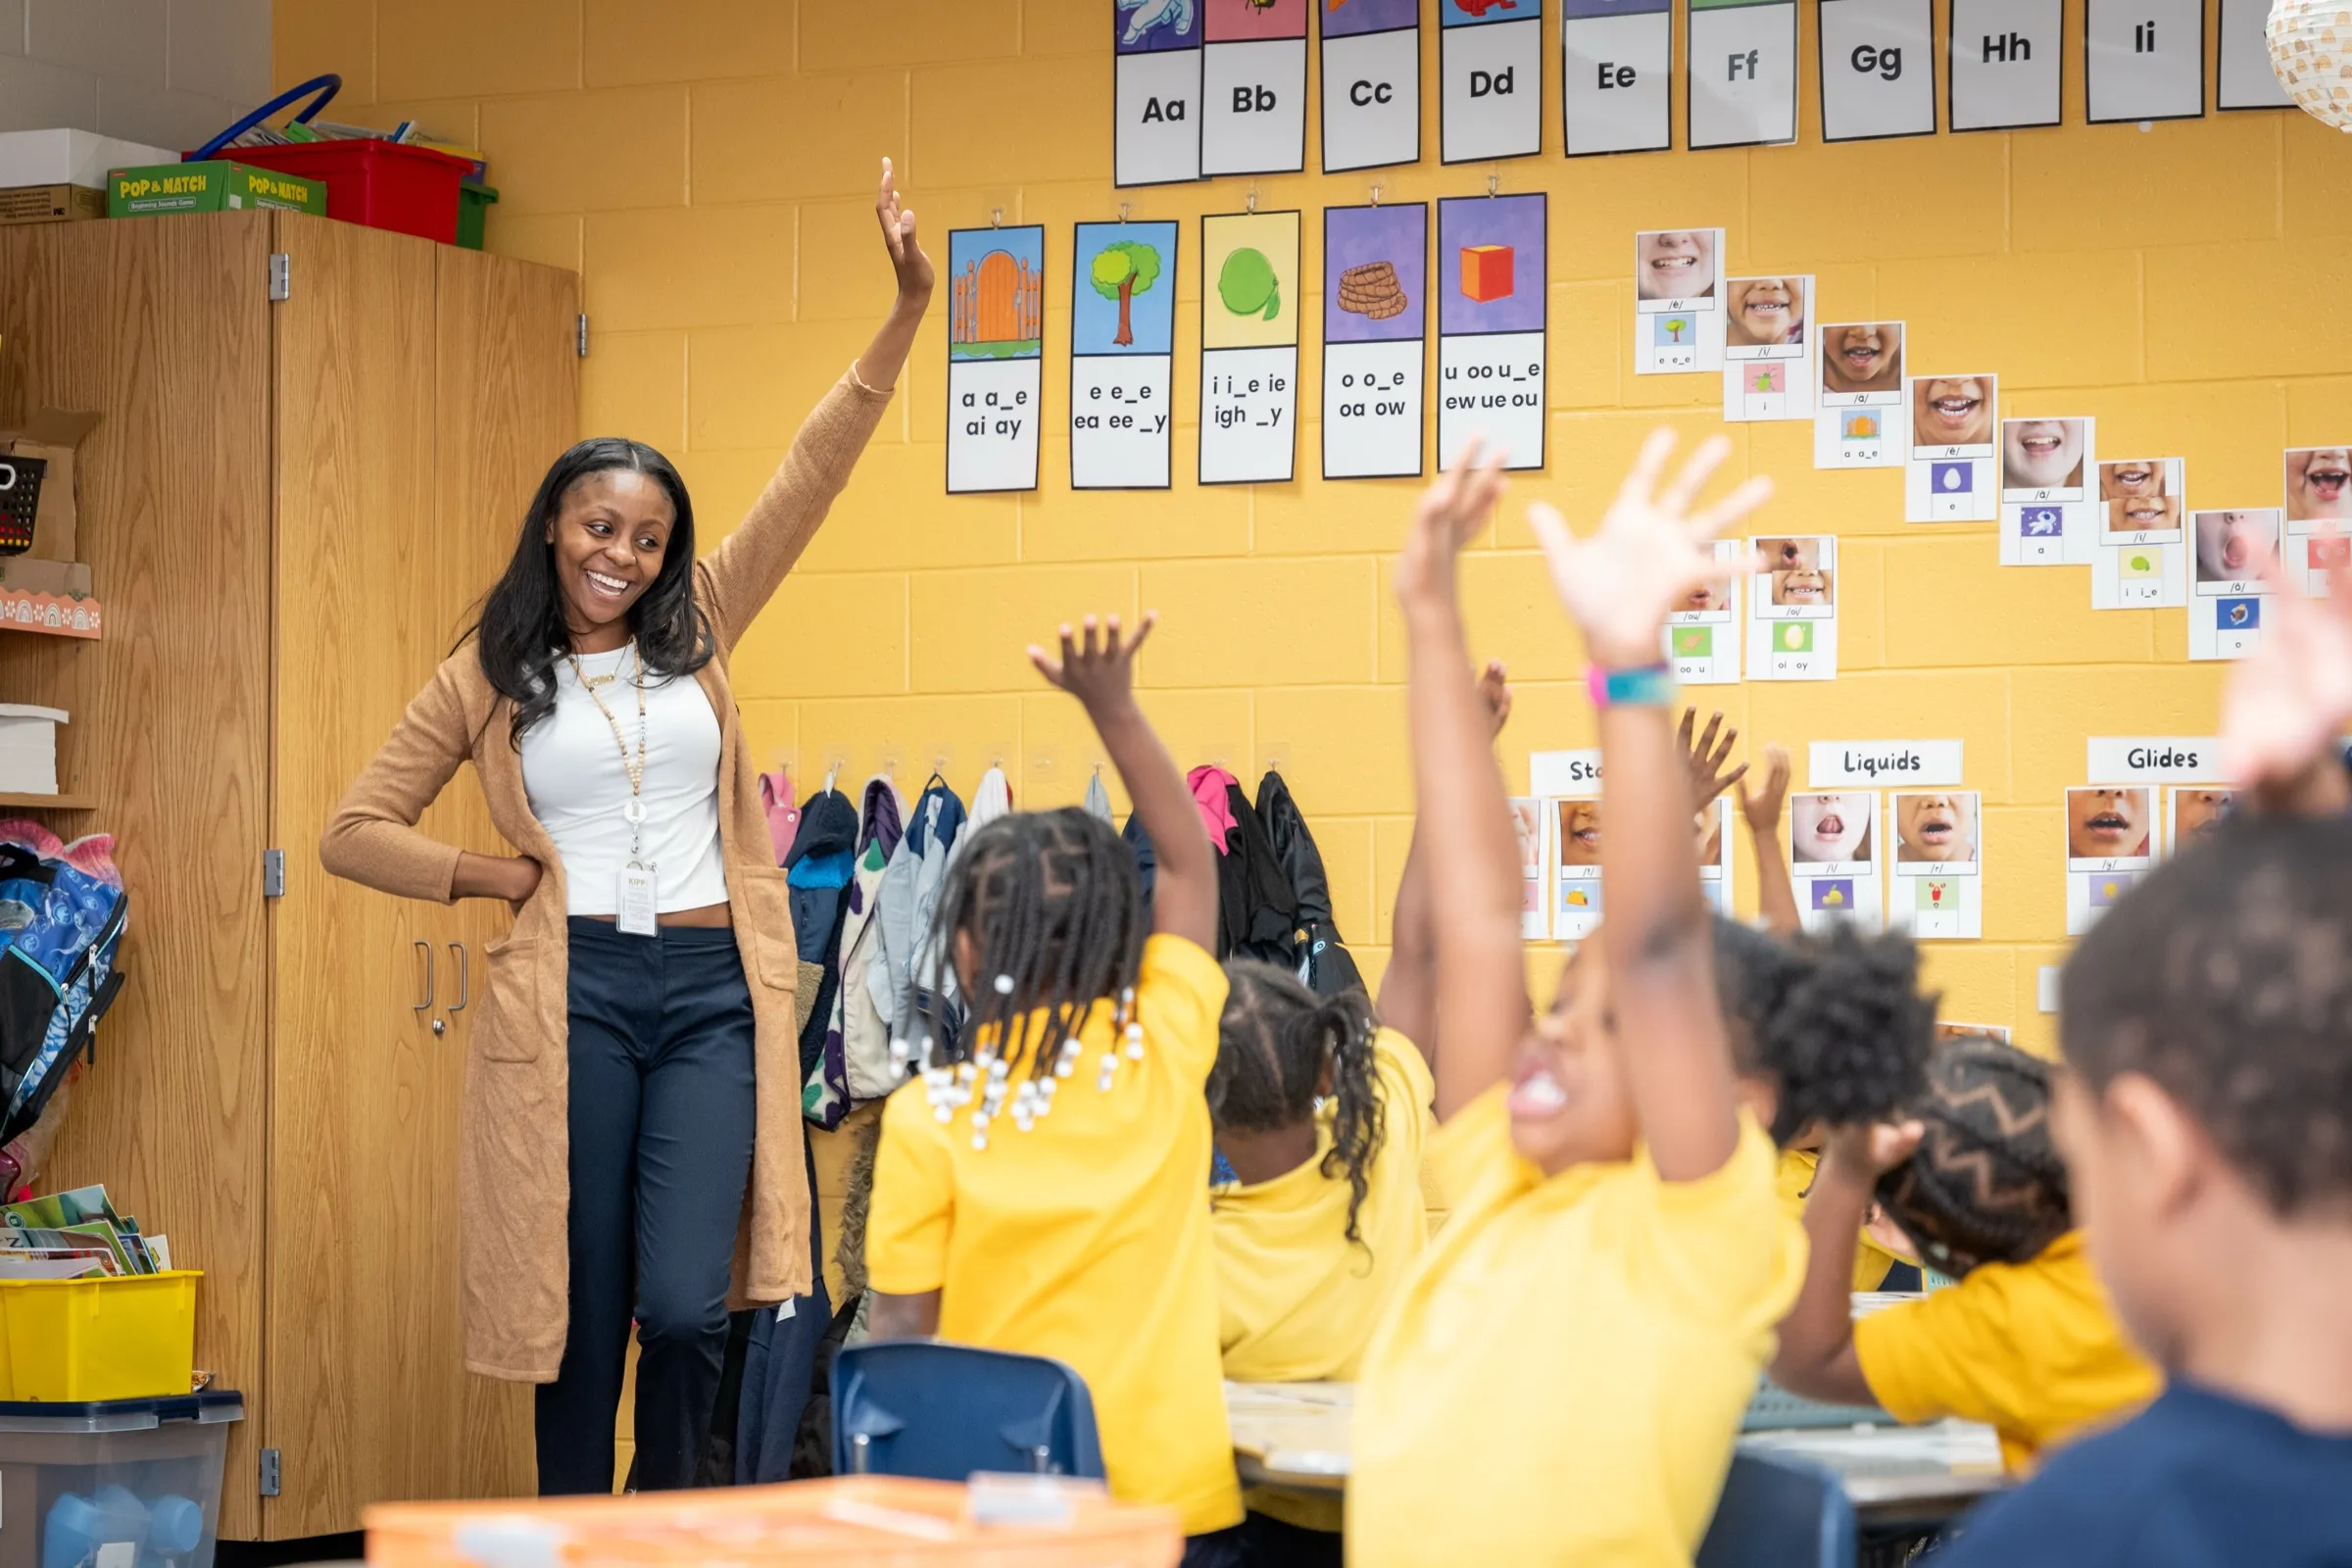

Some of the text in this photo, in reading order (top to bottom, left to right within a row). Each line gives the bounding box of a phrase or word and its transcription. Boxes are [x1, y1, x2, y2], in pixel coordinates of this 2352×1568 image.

[1983, 31, 2032, 64] Hh
[2135, 20, 2156, 54] Ii
[1728, 48, 1759, 82] Ff
[1850, 44, 1902, 81] Gg
[1470, 66, 1514, 99] Dd
[1597, 62, 1637, 90] Ee
[1232, 84, 1277, 114] Bb
[1349, 79, 1393, 107] Cc
[1141, 96, 1186, 124] Aa
[121, 175, 207, 198] POP & MATCH
[249, 175, 308, 203] POP & MATCH
[1213, 372, 1286, 399] i i_e ie
[1342, 371, 1405, 391] o o_e
[1445, 363, 1541, 382] u oo u_e
[961, 390, 1028, 412] a a_e
[1089, 385, 1152, 405] e e_e
[1446, 393, 1538, 411] ew ue ou
[1214, 405, 1283, 429] igh _y
[1339, 401, 1406, 417] oa ow
[965, 415, 1022, 441] ai ay
[1074, 414, 1167, 434] ea ee _y
[1778, 661, 1808, 671] oi oy
[1843, 749, 1921, 778] Liquids
[2127, 746, 2199, 769] Glides
